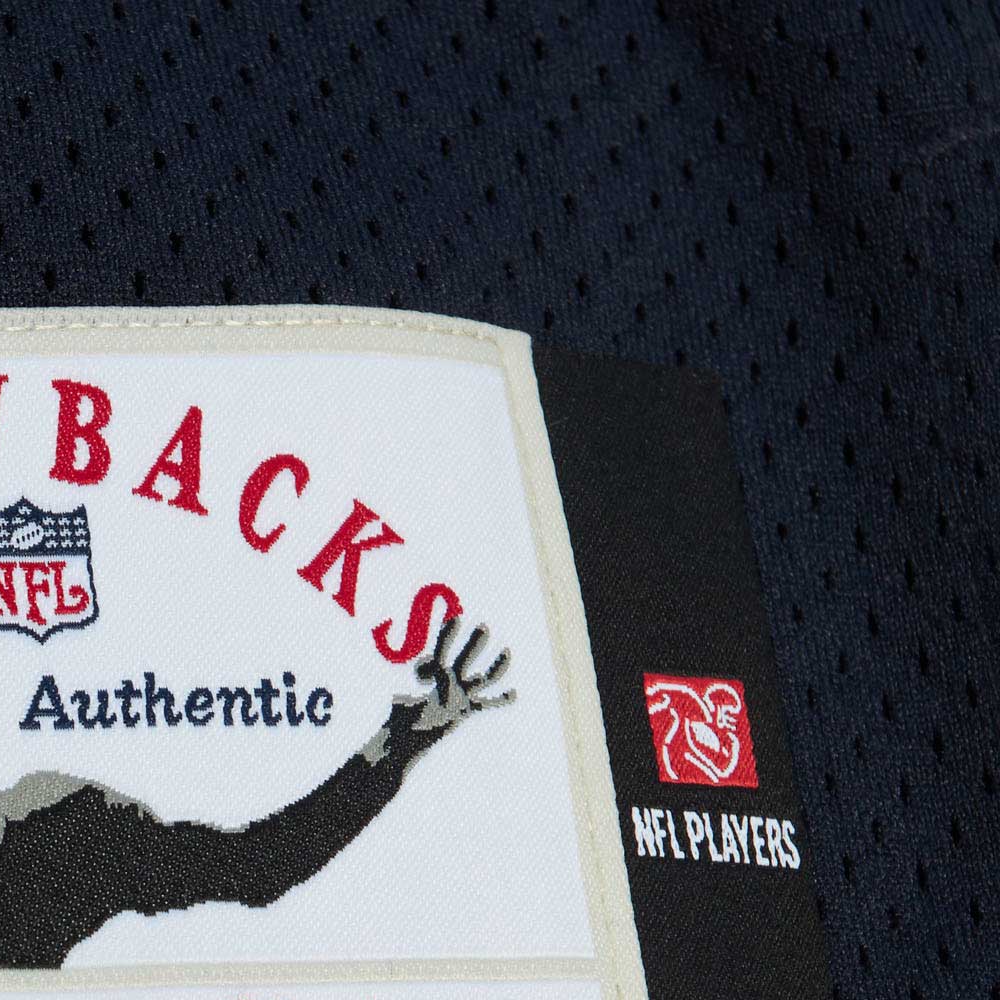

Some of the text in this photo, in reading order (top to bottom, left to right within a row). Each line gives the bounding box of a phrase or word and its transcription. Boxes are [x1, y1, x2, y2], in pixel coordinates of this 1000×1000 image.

[18, 671, 333, 731] Authentic
[631, 806, 801, 870] NFL PLAYERS
